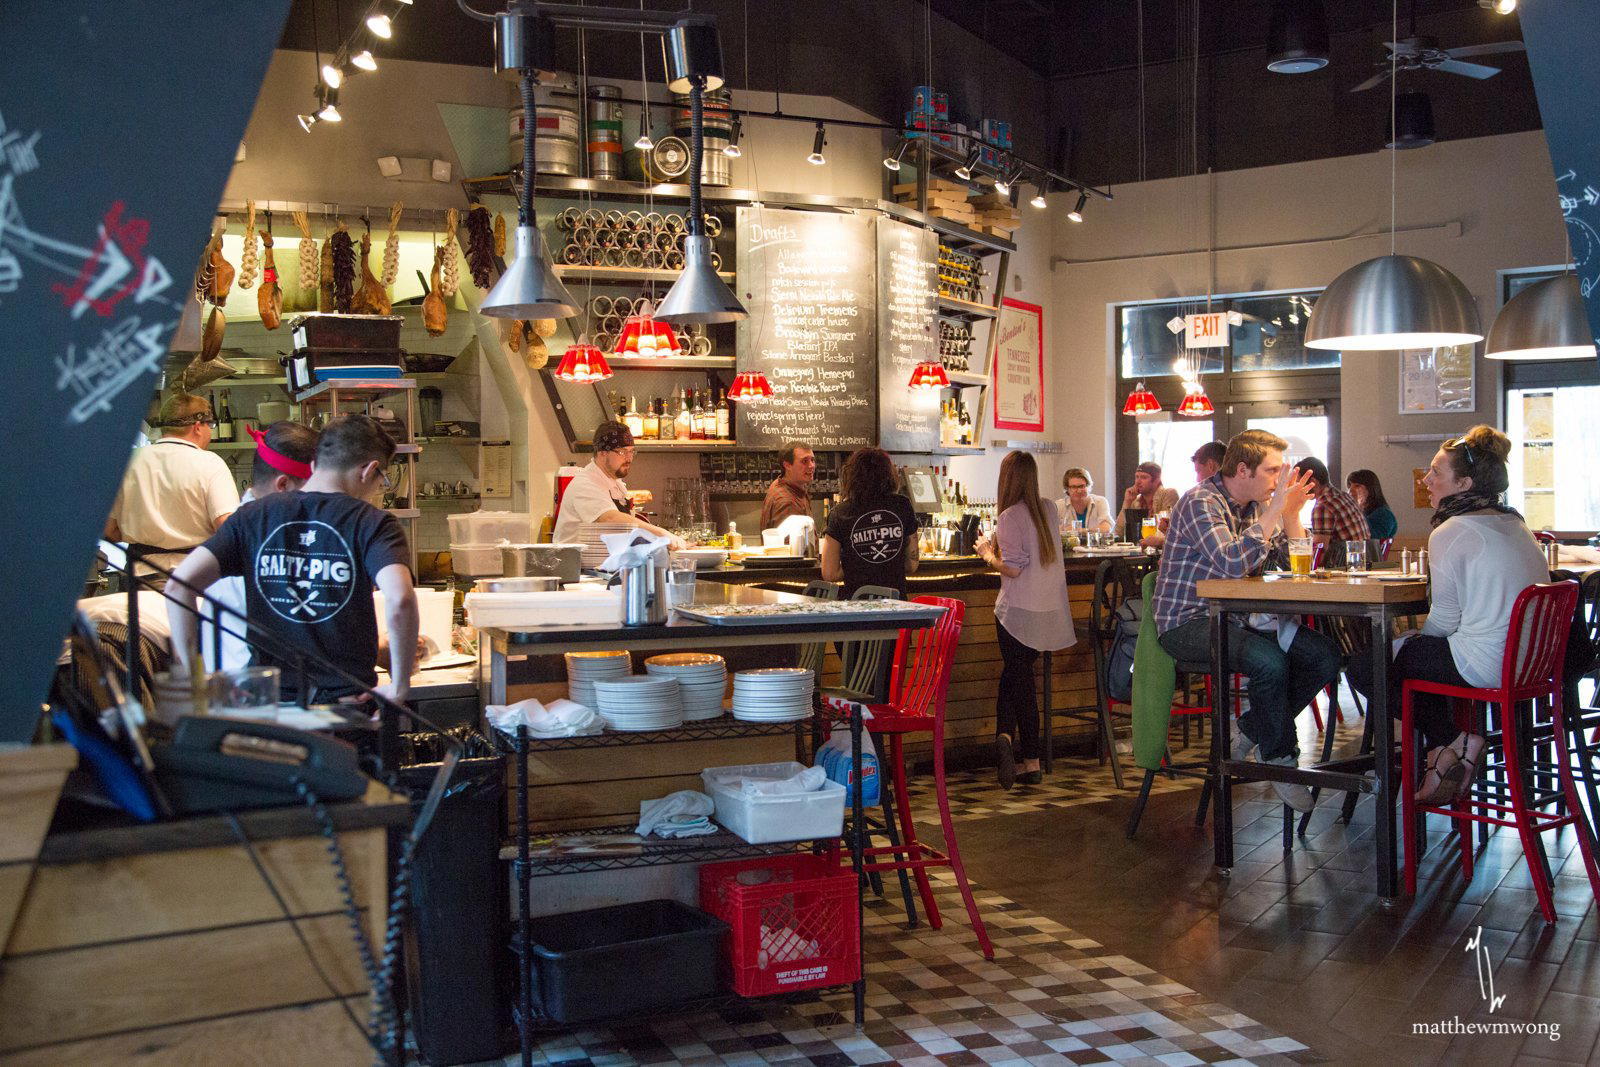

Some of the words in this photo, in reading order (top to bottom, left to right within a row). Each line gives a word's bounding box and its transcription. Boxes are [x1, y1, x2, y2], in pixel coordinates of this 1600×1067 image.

[750, 224, 797, 243] Drafts
[772, 304, 815, 316] Delirium
[817, 304, 858, 316] Tremens
[828, 316, 850, 326] house
[1194, 314, 1220, 337] EXIT
[775, 326, 820, 342] Brooklyn
[820, 327, 856, 341] Summer
[824, 341, 838, 352] IPA
[789, 351, 822, 364] Arrogant
[823, 352, 854, 364] Bastard
[1007, 348, 1030, 364] TENNESSEE
[773, 368, 814, 382] Ommegang
[818, 367, 855, 380] Hennepin
[768, 380, 788, 392] Bear
[789, 380, 819, 394] Republic
[774, 412, 797, 426] spring
[798, 412, 805, 420] is
[853, 528, 878, 544] SALTY
[880, 526, 902, 539] PIG
[260, 554, 305, 578] SALTY
[308, 558, 351, 582] PIG
